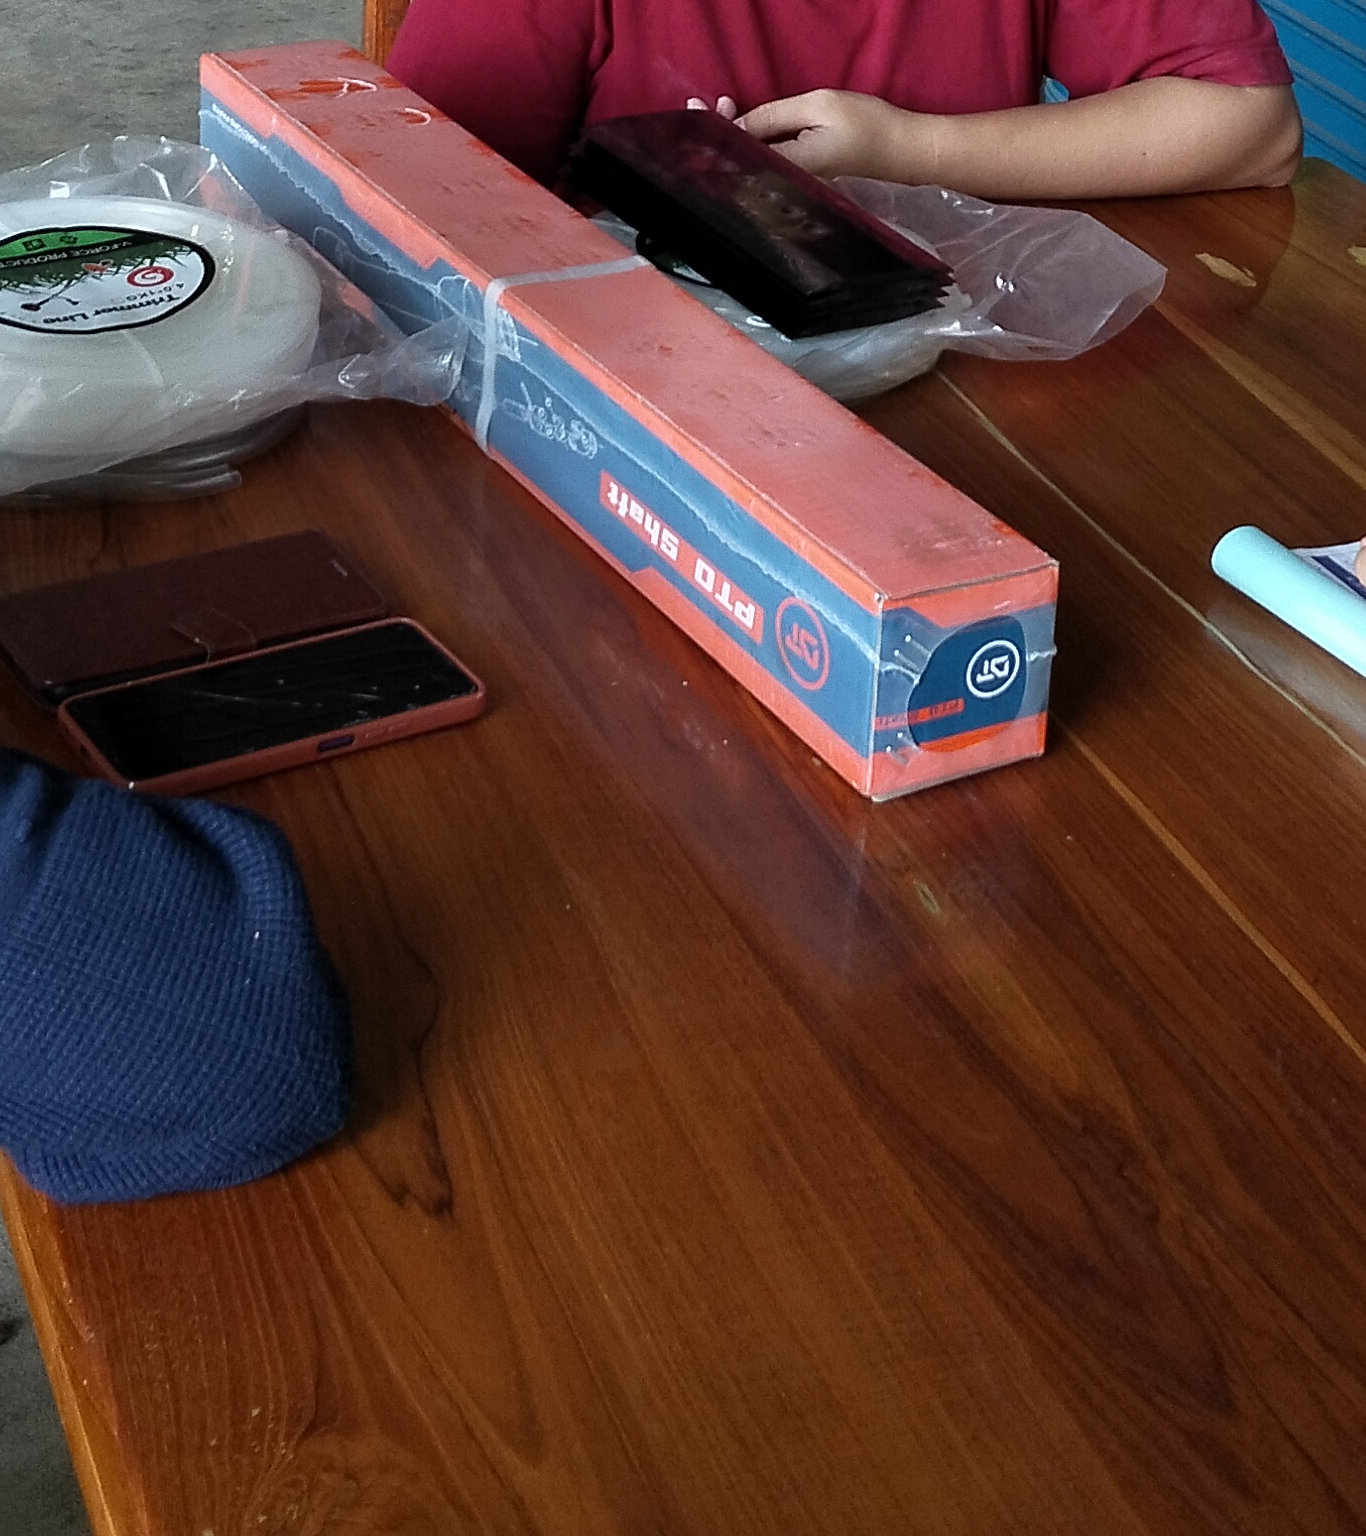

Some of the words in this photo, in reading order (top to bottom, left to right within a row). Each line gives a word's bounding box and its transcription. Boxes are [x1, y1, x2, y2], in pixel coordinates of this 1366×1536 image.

[71, 240, 133, 258] V-FORCE
[43, 310, 89, 324] Line
[94, 295, 182, 317] Trimmer
[607, 481, 679, 561] Shaft
[694, 557, 755, 629] PTO
